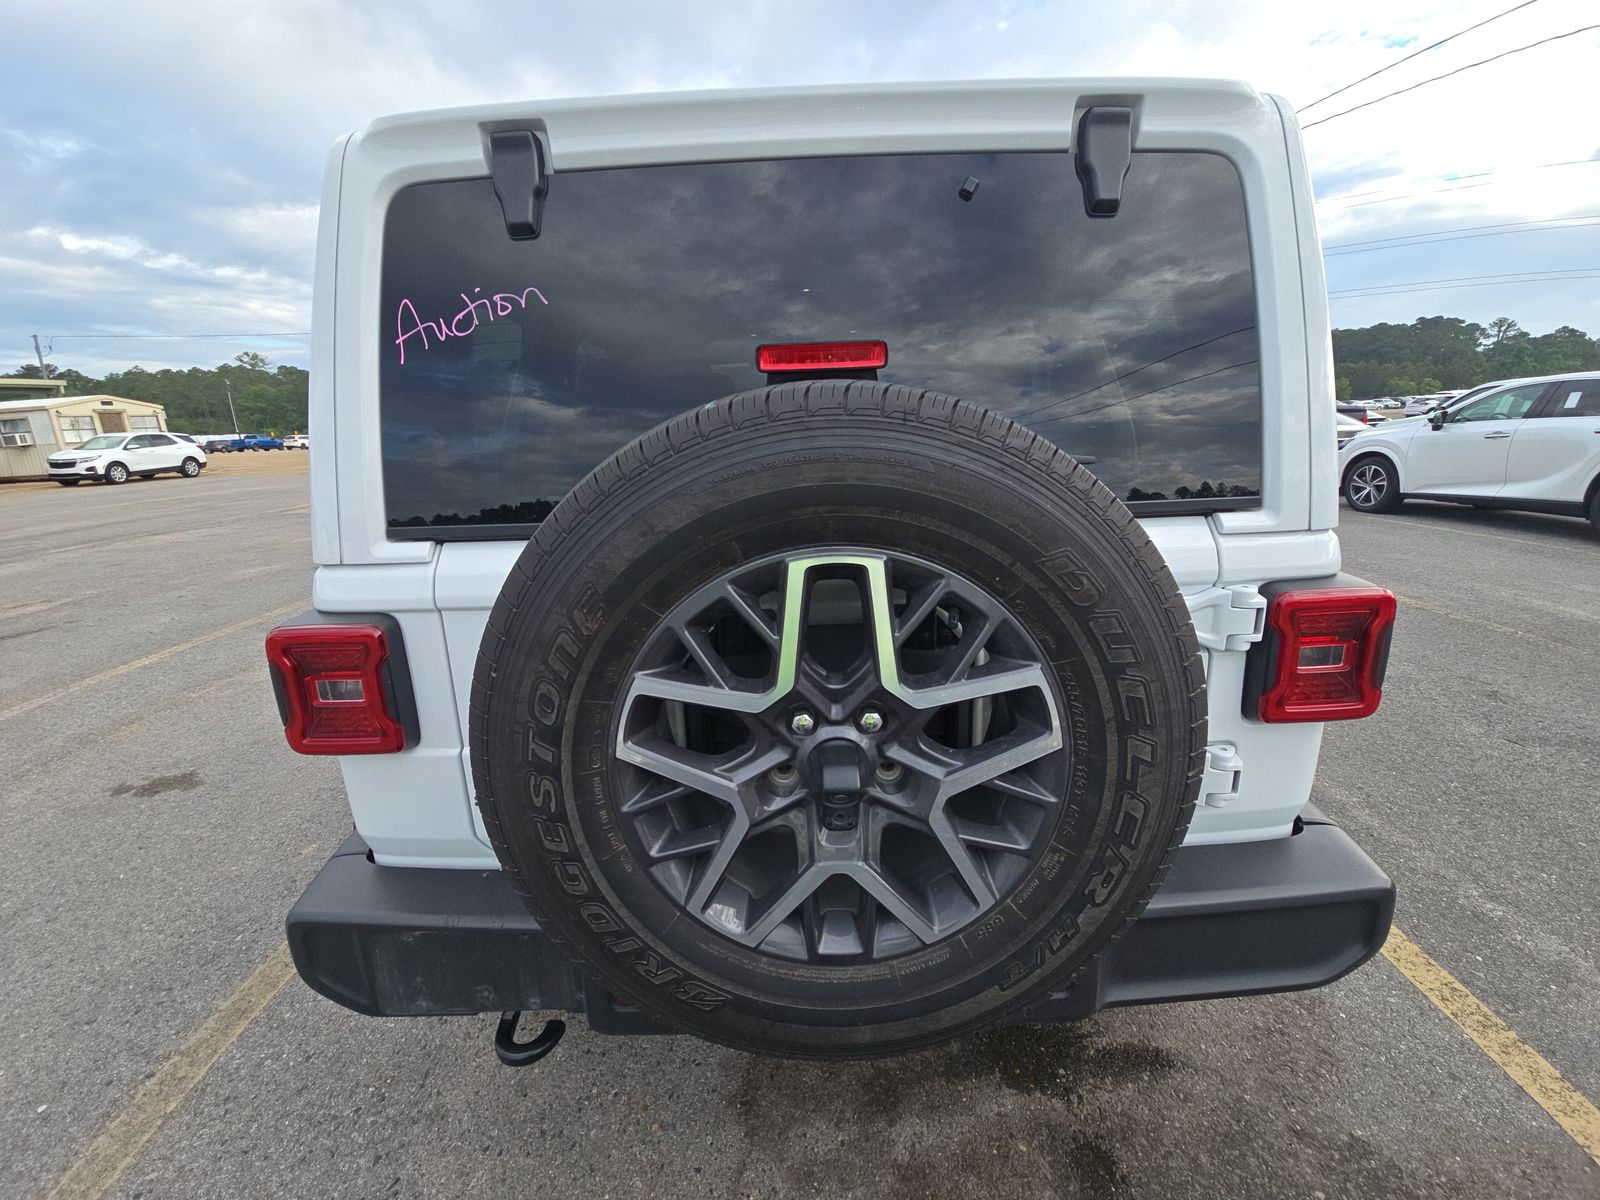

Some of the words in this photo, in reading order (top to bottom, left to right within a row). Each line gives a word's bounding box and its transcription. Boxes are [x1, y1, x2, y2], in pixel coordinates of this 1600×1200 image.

[395, 286, 549, 366] Auction
[522, 581, 733, 1012] BRIDGESTONE
[1036, 549, 1159, 907] DUELER
[996, 912, 1081, 992] H/T
